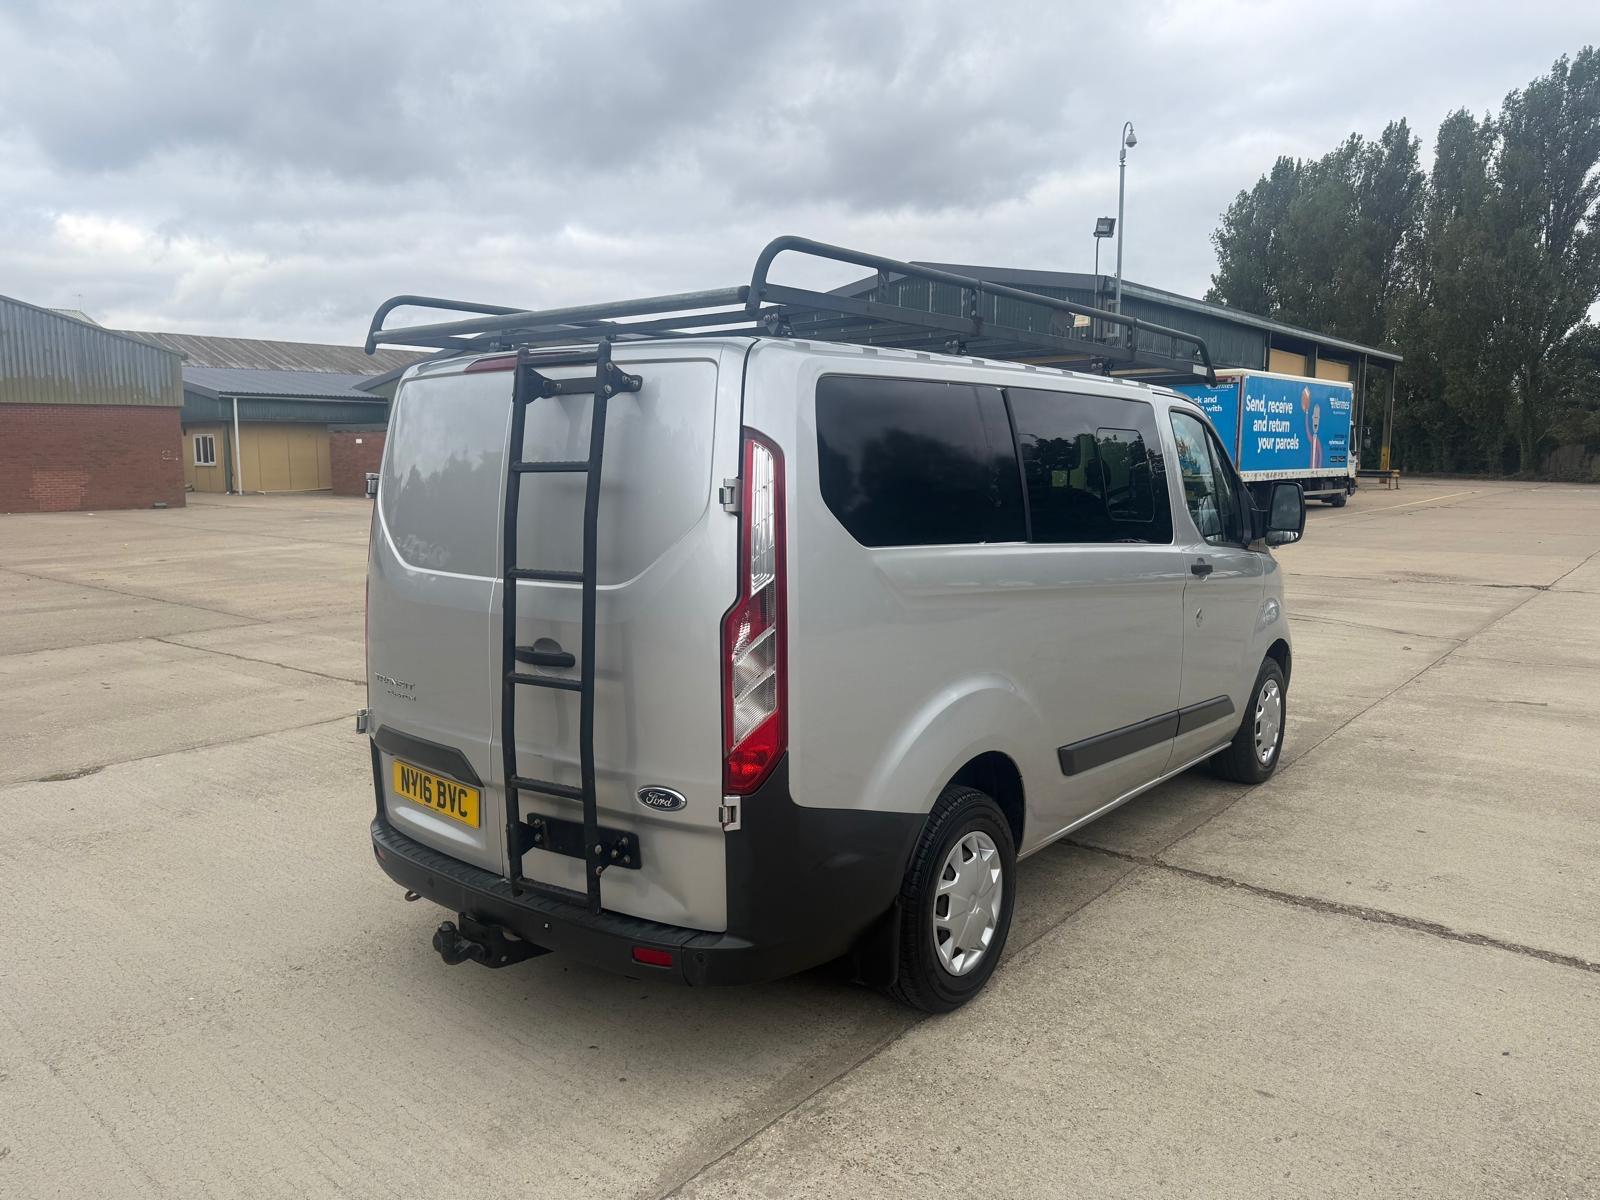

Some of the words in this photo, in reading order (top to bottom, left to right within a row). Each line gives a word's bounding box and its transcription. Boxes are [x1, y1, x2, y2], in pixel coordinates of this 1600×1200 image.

[1203, 395, 1217, 403] and
[1246, 394, 1267, 416] Send,
[1267, 395, 1293, 414] receive
[1253, 415, 1268, 432] and
[1268, 418, 1290, 432] return
[1257, 437, 1274, 454] your
[1274, 433, 1299, 454] parcels
[401, 766, 433, 804] NY16
[437, 779, 468, 818] BVC
[645, 790, 673, 808] Ford
